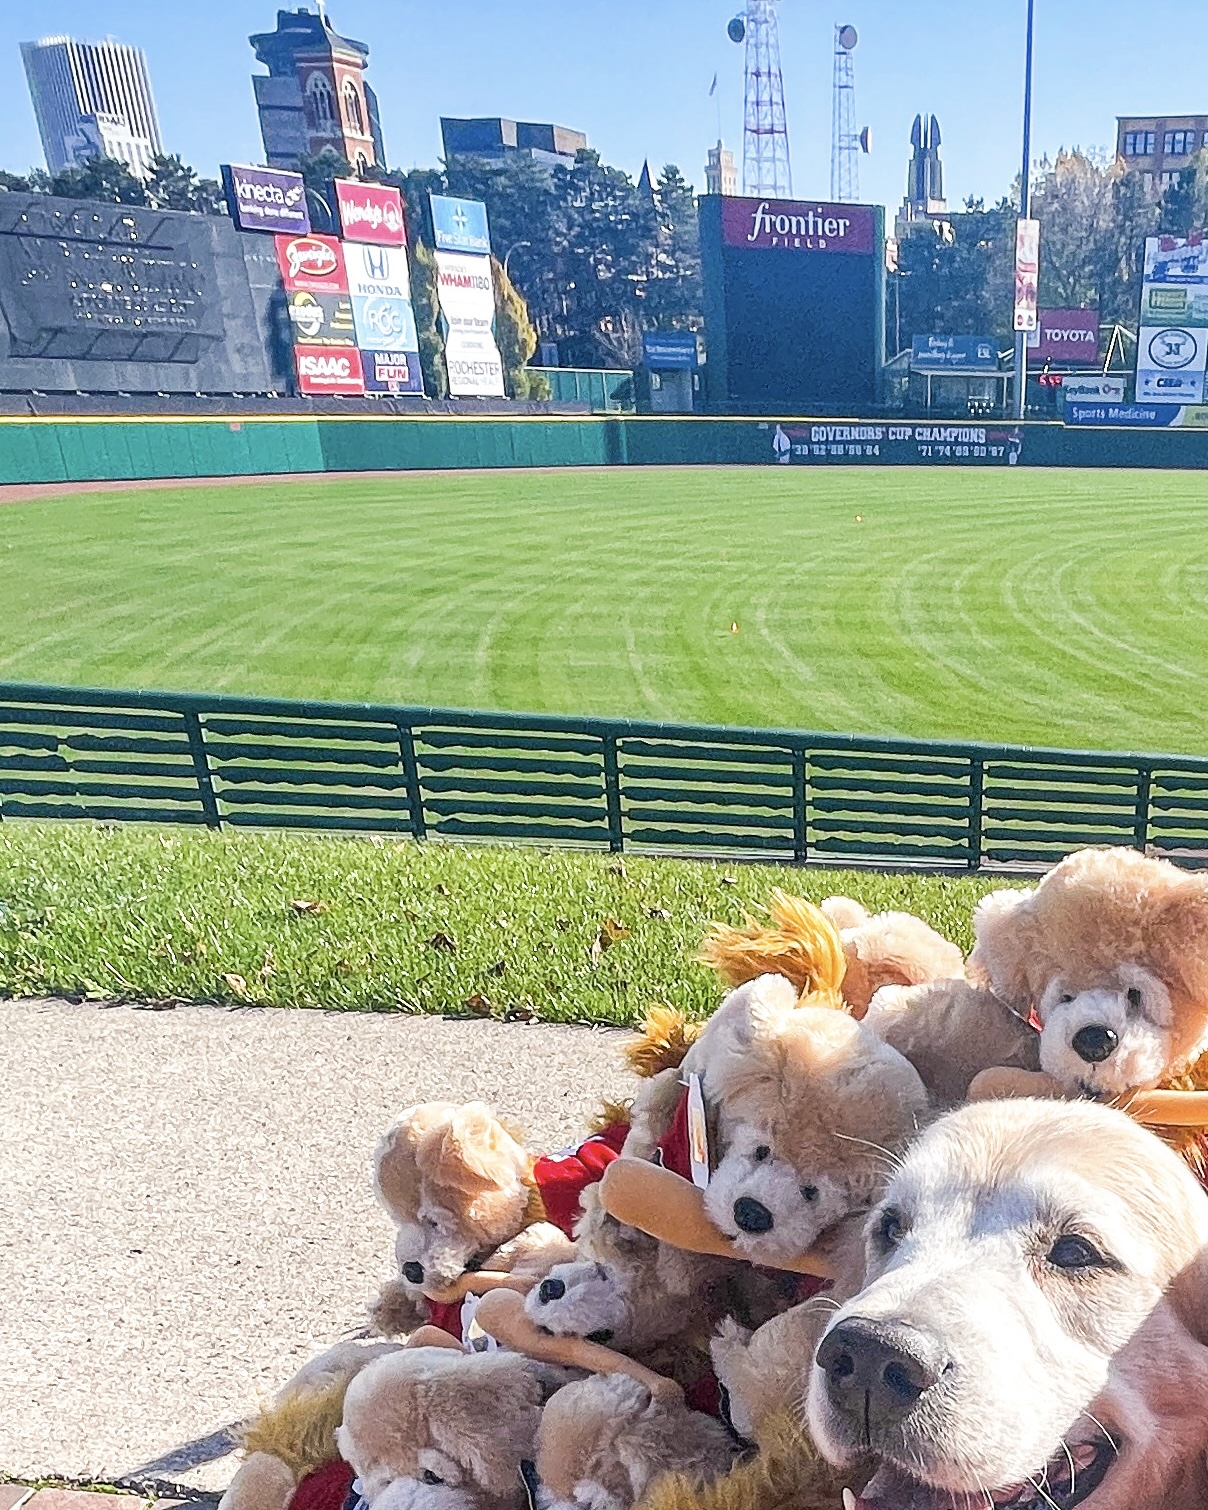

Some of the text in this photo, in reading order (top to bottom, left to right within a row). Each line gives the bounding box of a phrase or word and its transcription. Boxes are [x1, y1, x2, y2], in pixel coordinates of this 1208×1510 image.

[235, 177, 284, 204] kinecta
[341, 199, 382, 229] Wendy's
[747, 201, 850, 241] frontier
[772, 237, 826, 248] FIELD
[357, 284, 402, 296] HONDA
[1044, 329, 1095, 342] TOYOTA
[300, 356, 350, 376] ISAAC
[374, 353, 406, 365] MAJOR
[378, 368, 406, 379] FUN
[449, 360, 499, 375] ROCHESTER
[1072, 407, 1156, 420] Sports Medicine
[811, 425, 986, 443] GOVERNORS' CUP CHAMPIONS
